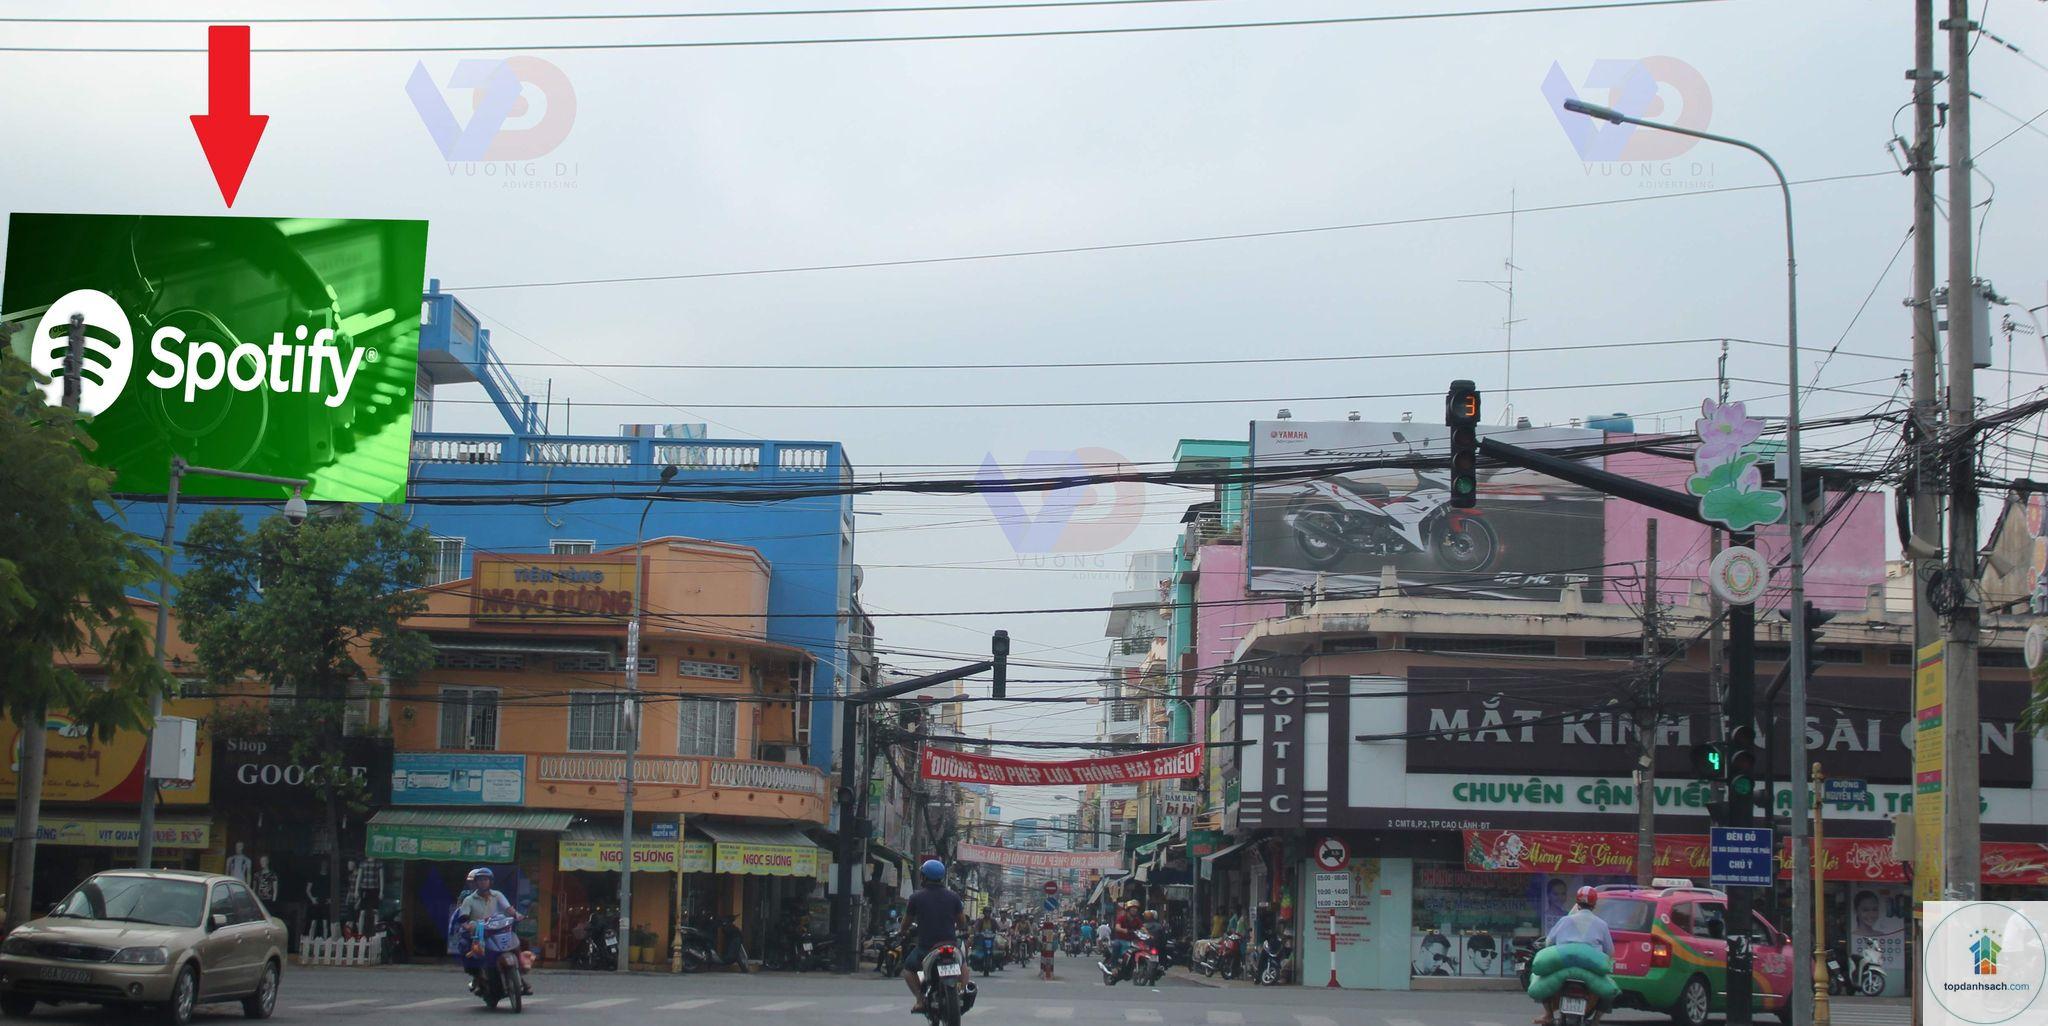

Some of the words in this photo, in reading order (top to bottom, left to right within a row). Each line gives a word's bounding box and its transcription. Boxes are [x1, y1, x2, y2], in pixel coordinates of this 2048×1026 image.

[146, 325, 366, 408] Spotify
[1464, 397, 1477, 417] 3
[1278, 431, 1308, 440] YAMAHA
[482, 588, 548, 616] NGỌC
[1426, 692, 1543, 743] MẮT
[1804, 705, 1881, 752] SÀI
[227, 738, 267, 754] Shop
[1269, 687, 1296, 813] OPTIC
[1708, 752, 1719, 770] 4
[978, 763, 1006, 781] CHO
[1006, 763, 1041, 783] PHÉP
[1073, 763, 1123, 783] THÔNG
[1452, 778, 1563, 804] CHUYÊN
[1577, 779, 1633, 811] CẬN
[600, 850, 624, 864] NGỌ
[743, 853, 764, 867] NGỌC
[1591, 843, 1634, 870] Giáng
[1653, 847, 1672, 868] nh
